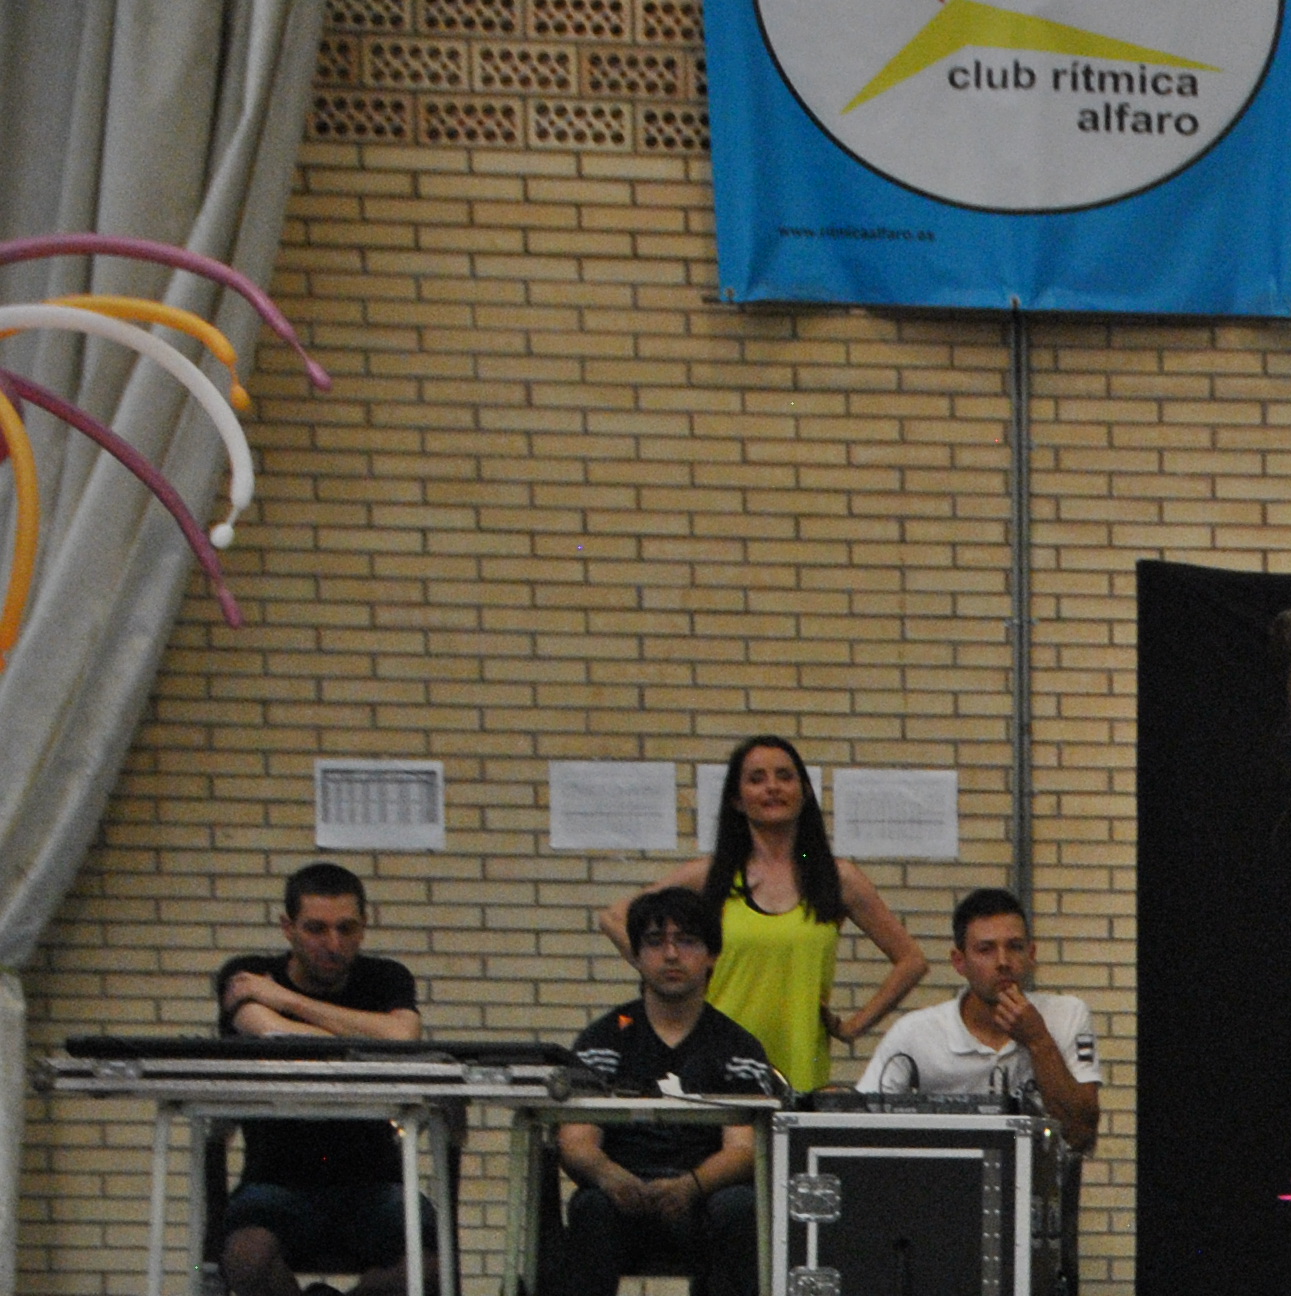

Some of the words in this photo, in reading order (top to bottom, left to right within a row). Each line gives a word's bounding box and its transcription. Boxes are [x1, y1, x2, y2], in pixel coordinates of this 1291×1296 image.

[947, 58, 1037, 91] club
[1052, 60, 1199, 98] rítmica
[1077, 102, 1200, 137] alfaro
